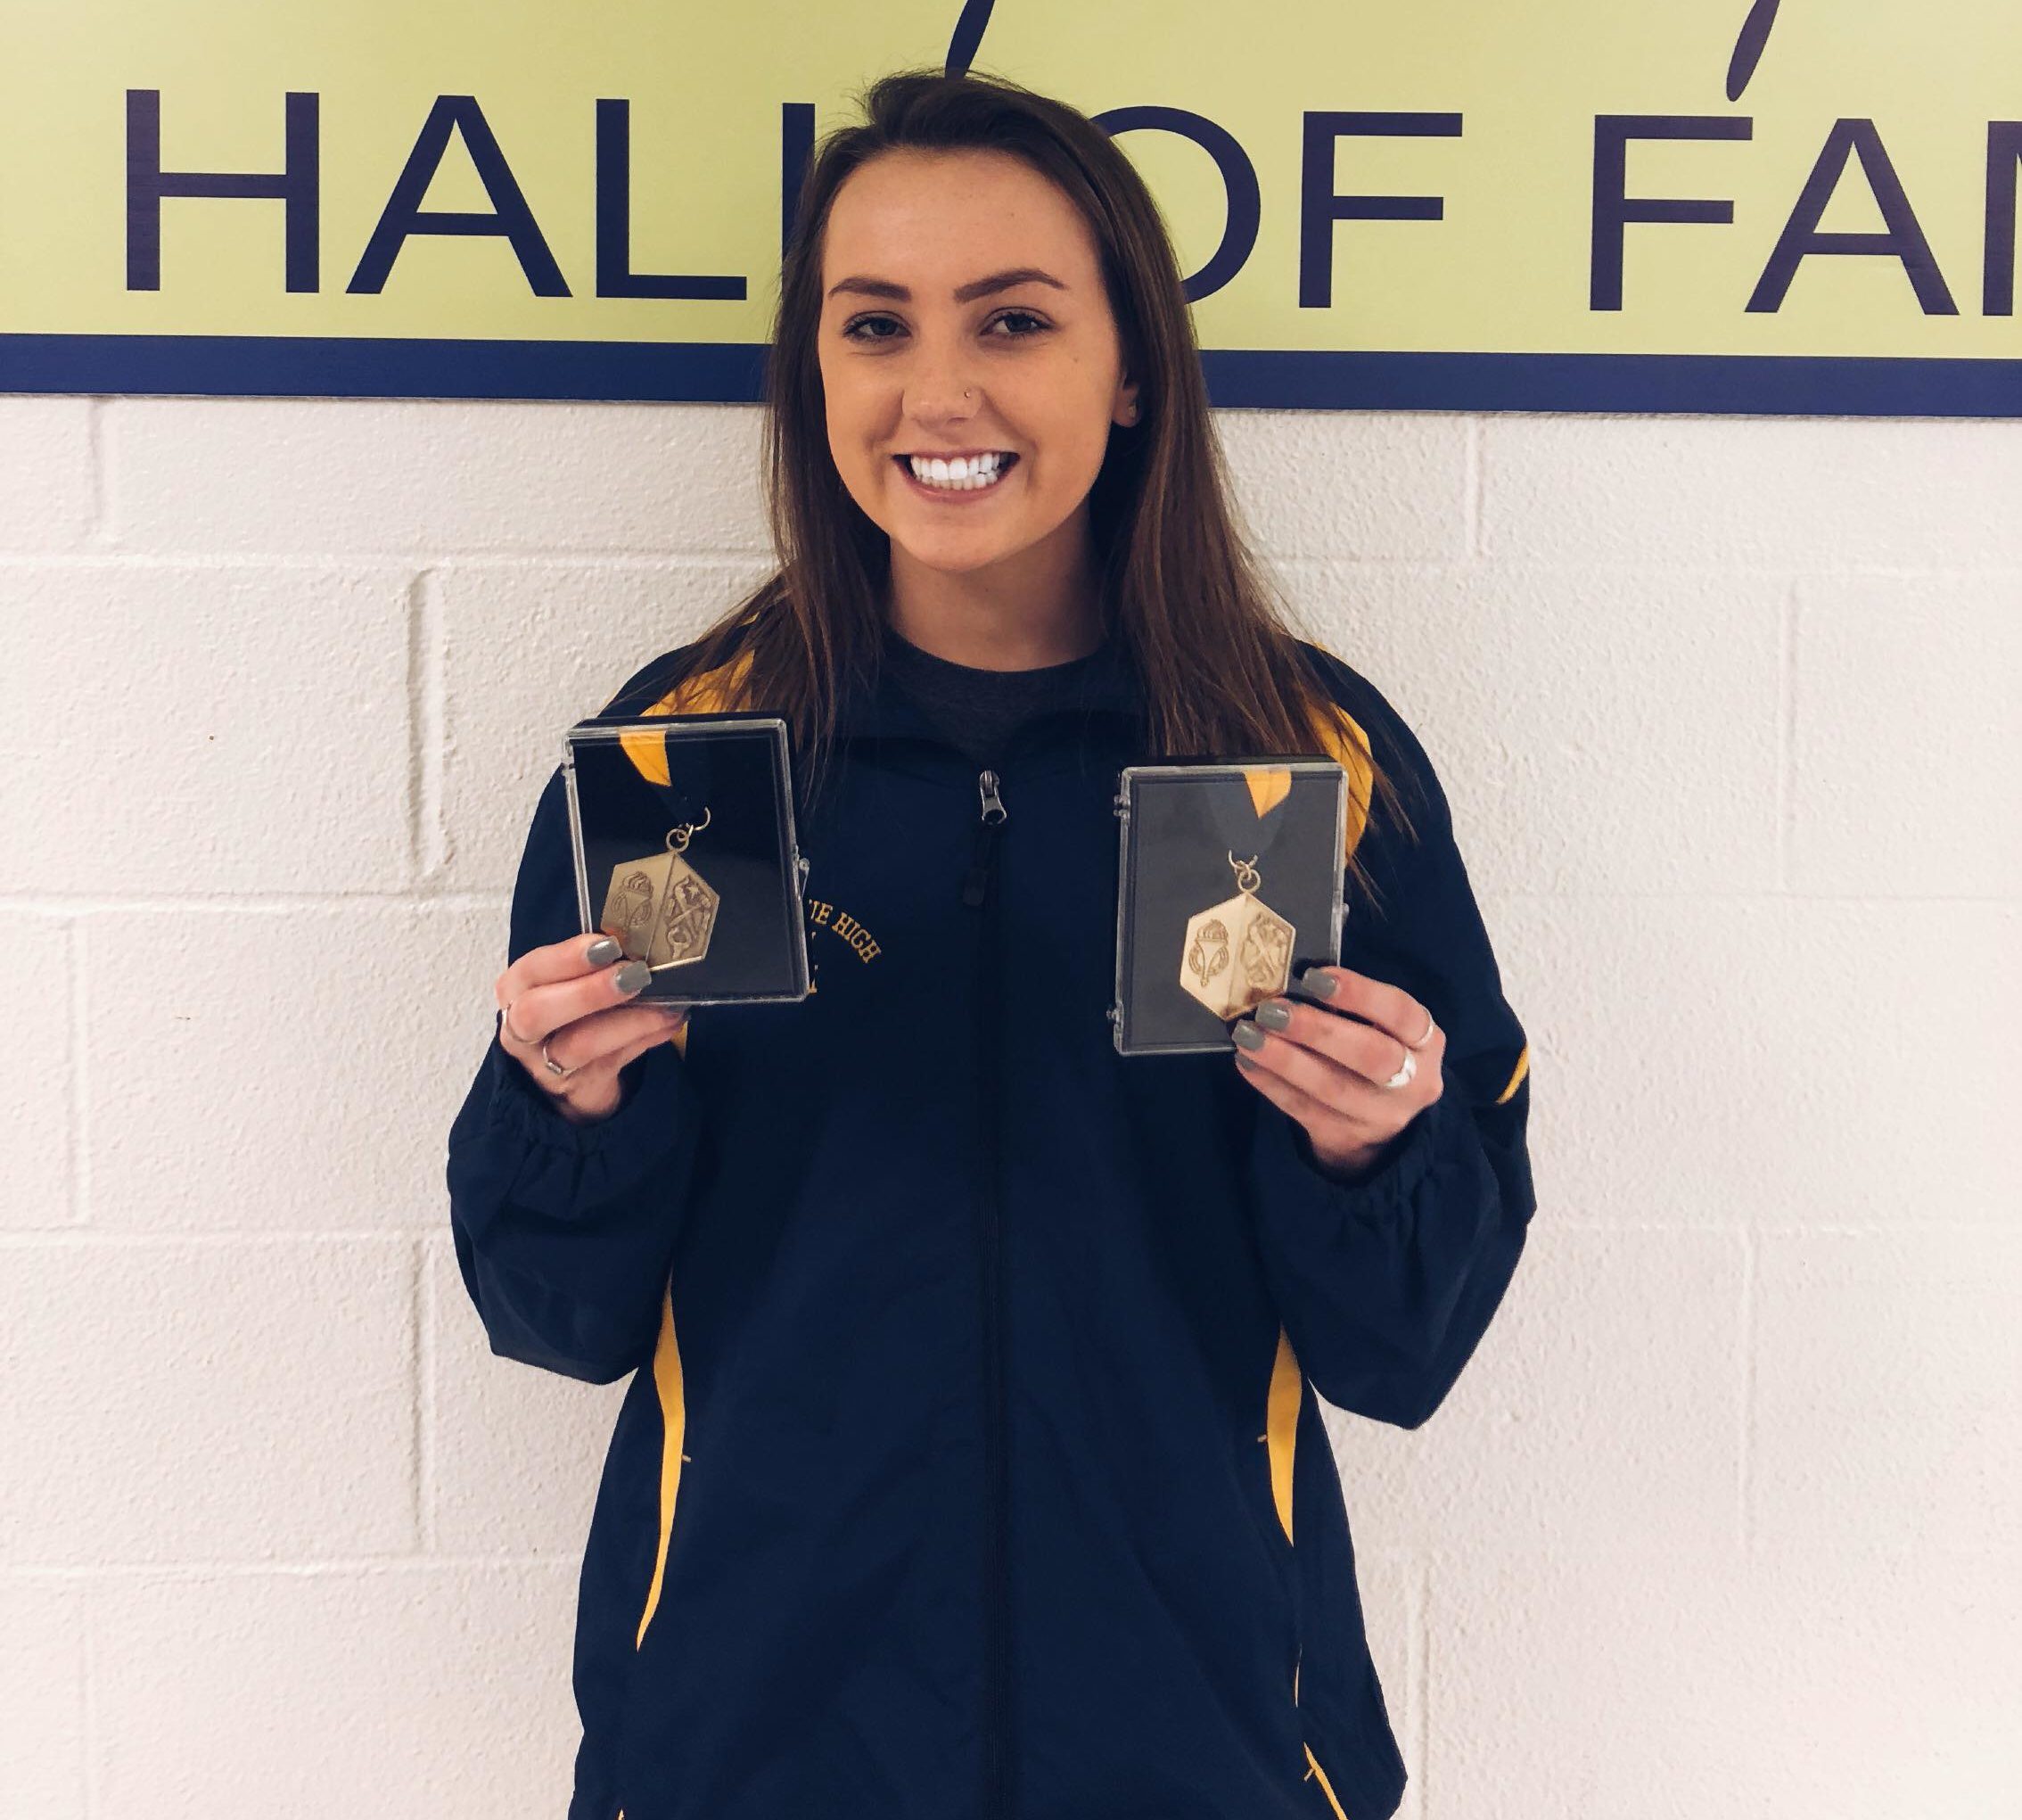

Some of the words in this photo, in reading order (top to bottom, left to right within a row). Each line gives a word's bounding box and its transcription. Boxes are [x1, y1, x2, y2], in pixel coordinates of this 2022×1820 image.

[1089, 105, 1463, 309] OF
[1590, 114, 2022, 316] FA
[832, 911, 881, 963] HIGH
